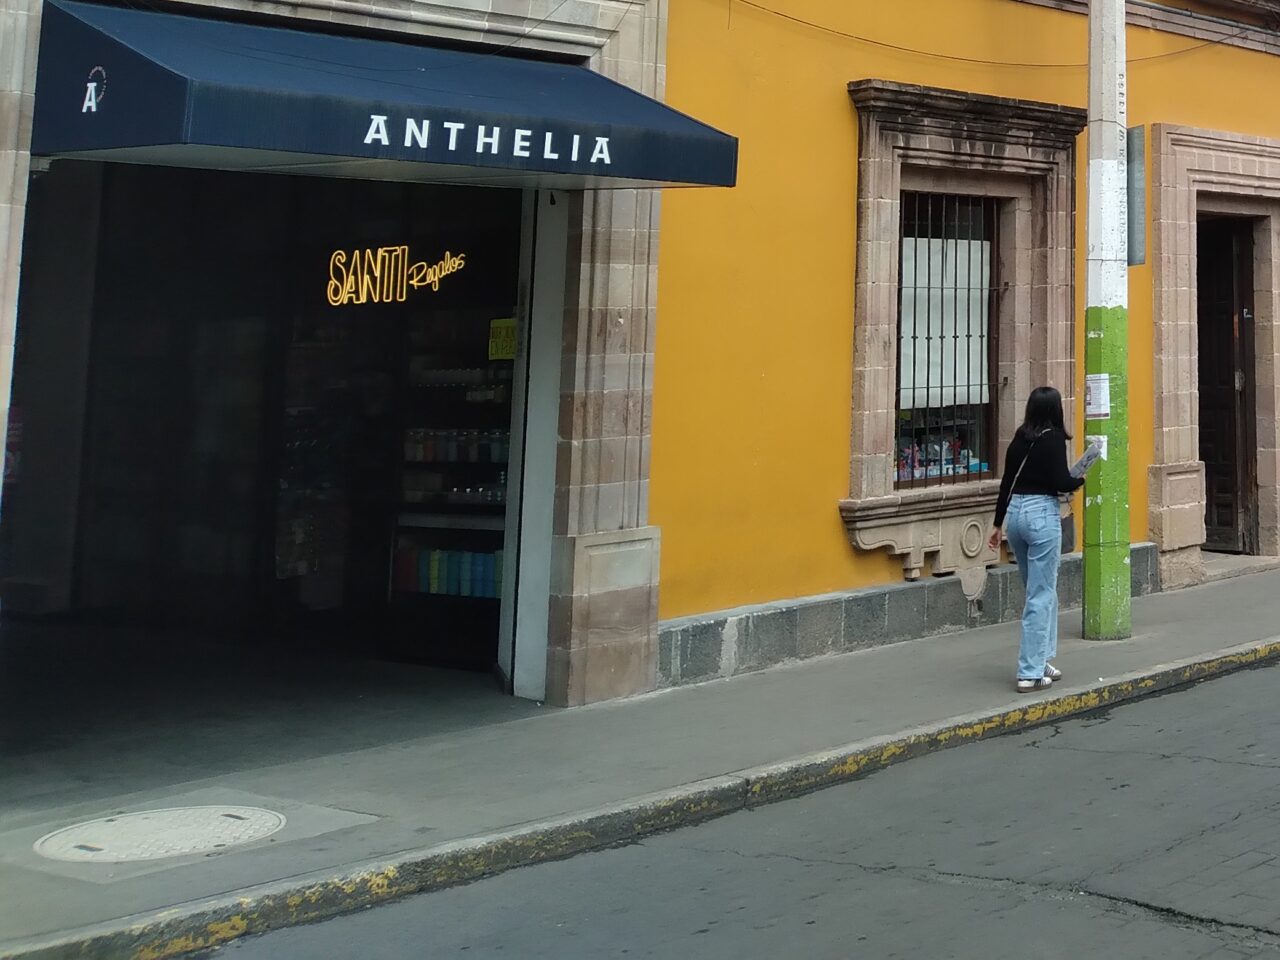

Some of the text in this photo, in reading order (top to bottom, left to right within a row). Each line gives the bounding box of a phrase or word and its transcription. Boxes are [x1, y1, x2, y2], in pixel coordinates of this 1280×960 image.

[82, 82, 97, 113] A
[363, 114, 612, 165] ANTHELIA
[327, 245, 467, 306] SANTI Regalos
